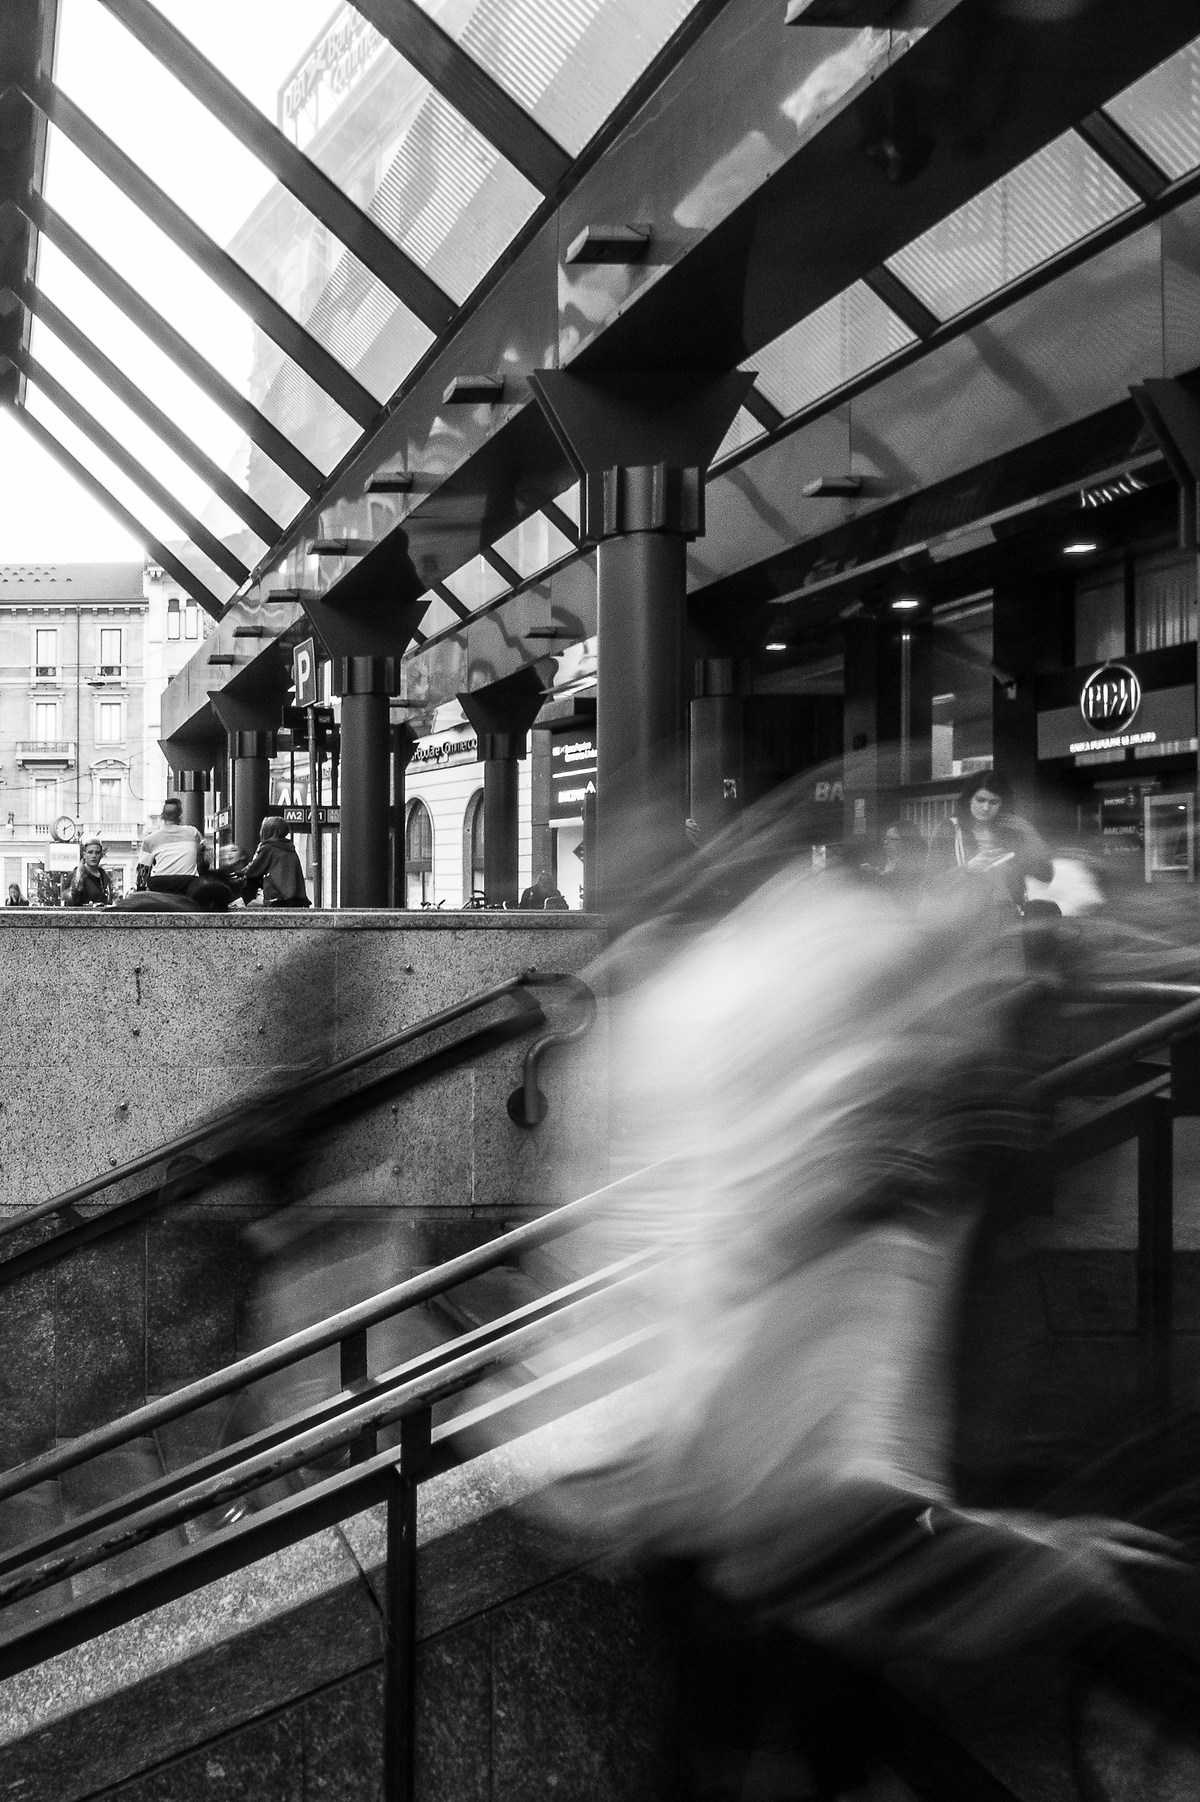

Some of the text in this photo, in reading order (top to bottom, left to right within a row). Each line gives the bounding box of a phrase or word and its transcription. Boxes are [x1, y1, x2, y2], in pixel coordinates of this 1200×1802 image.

[326, 9, 364, 66] Banc
[297, 650, 311, 700] P
[286, 811, 302, 820] M2
